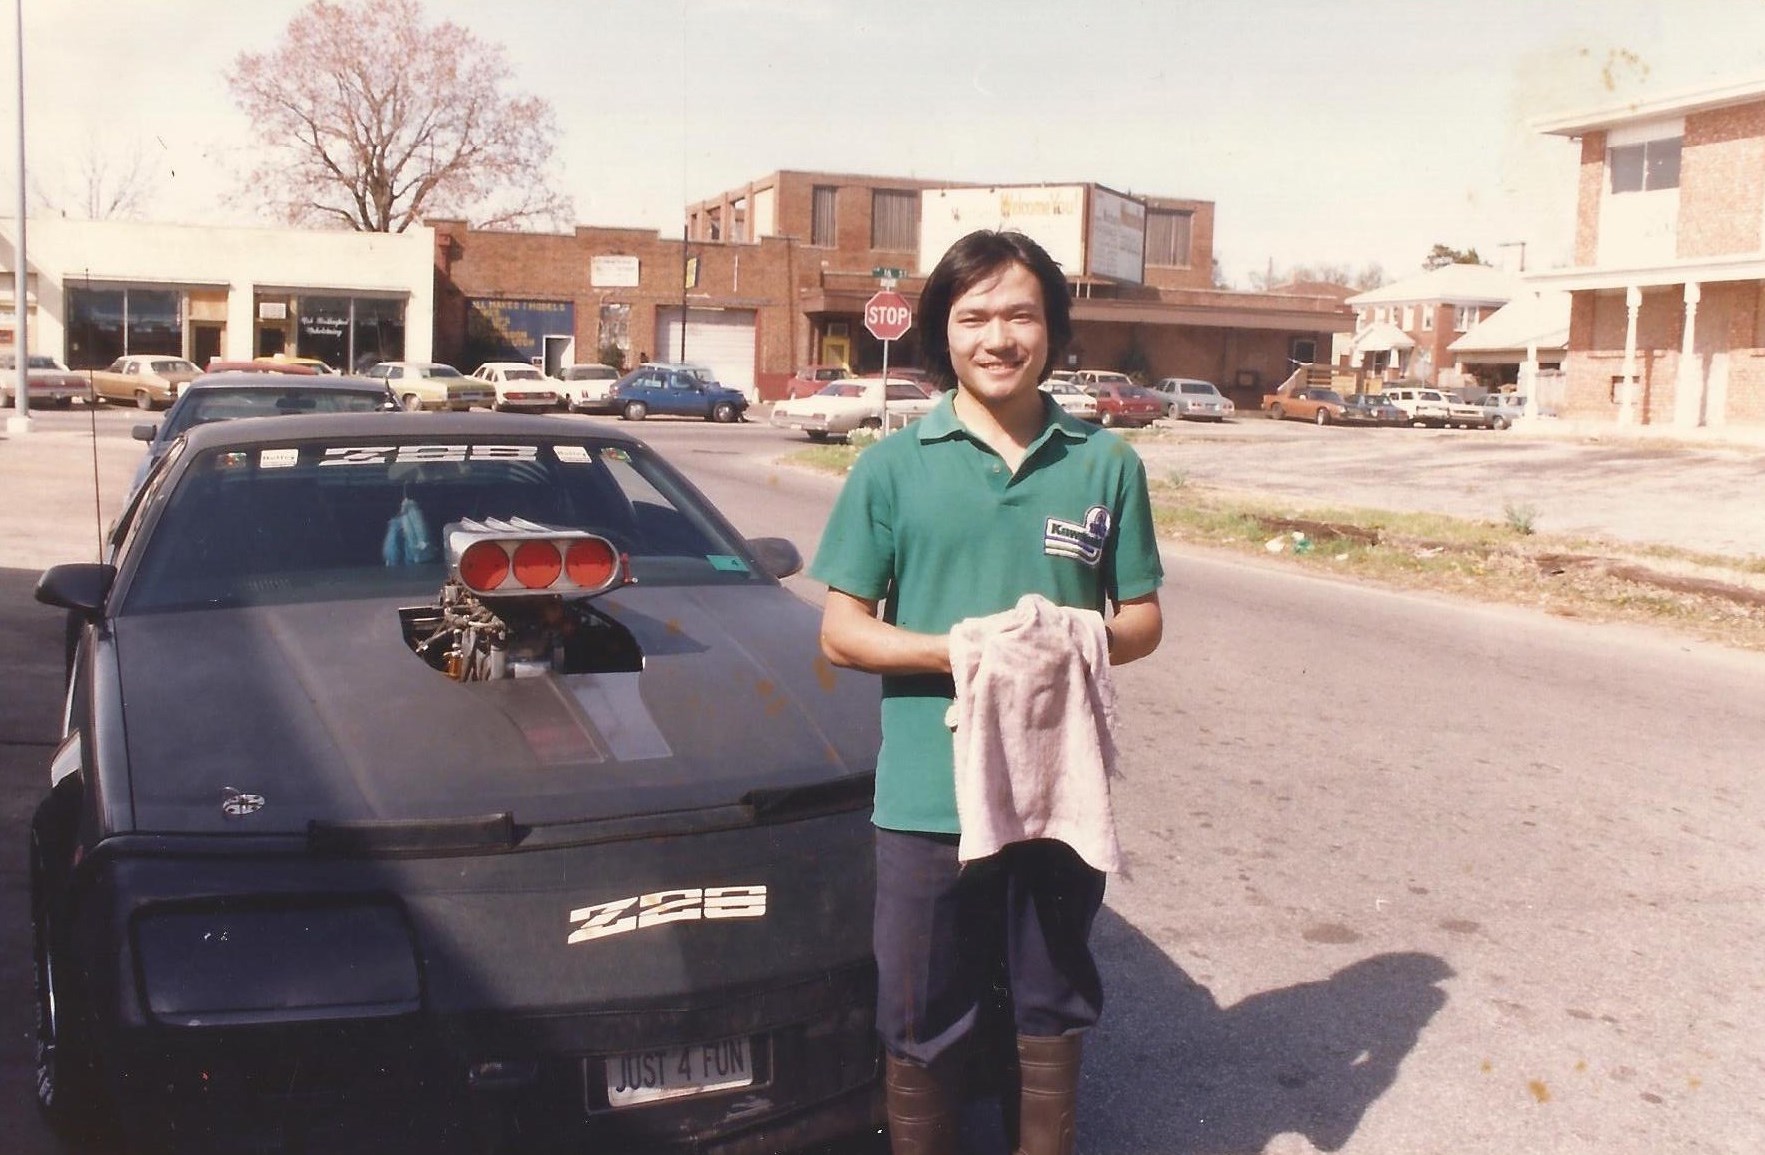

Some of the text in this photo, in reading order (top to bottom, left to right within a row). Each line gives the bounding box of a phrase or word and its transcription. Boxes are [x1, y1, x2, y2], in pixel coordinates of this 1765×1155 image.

[869, 306, 908, 325] STOP
[319, 445, 538, 466] Z28
[568, 885, 767, 944] Z28
[616, 1039, 744, 1092] JUST 4 FUN
